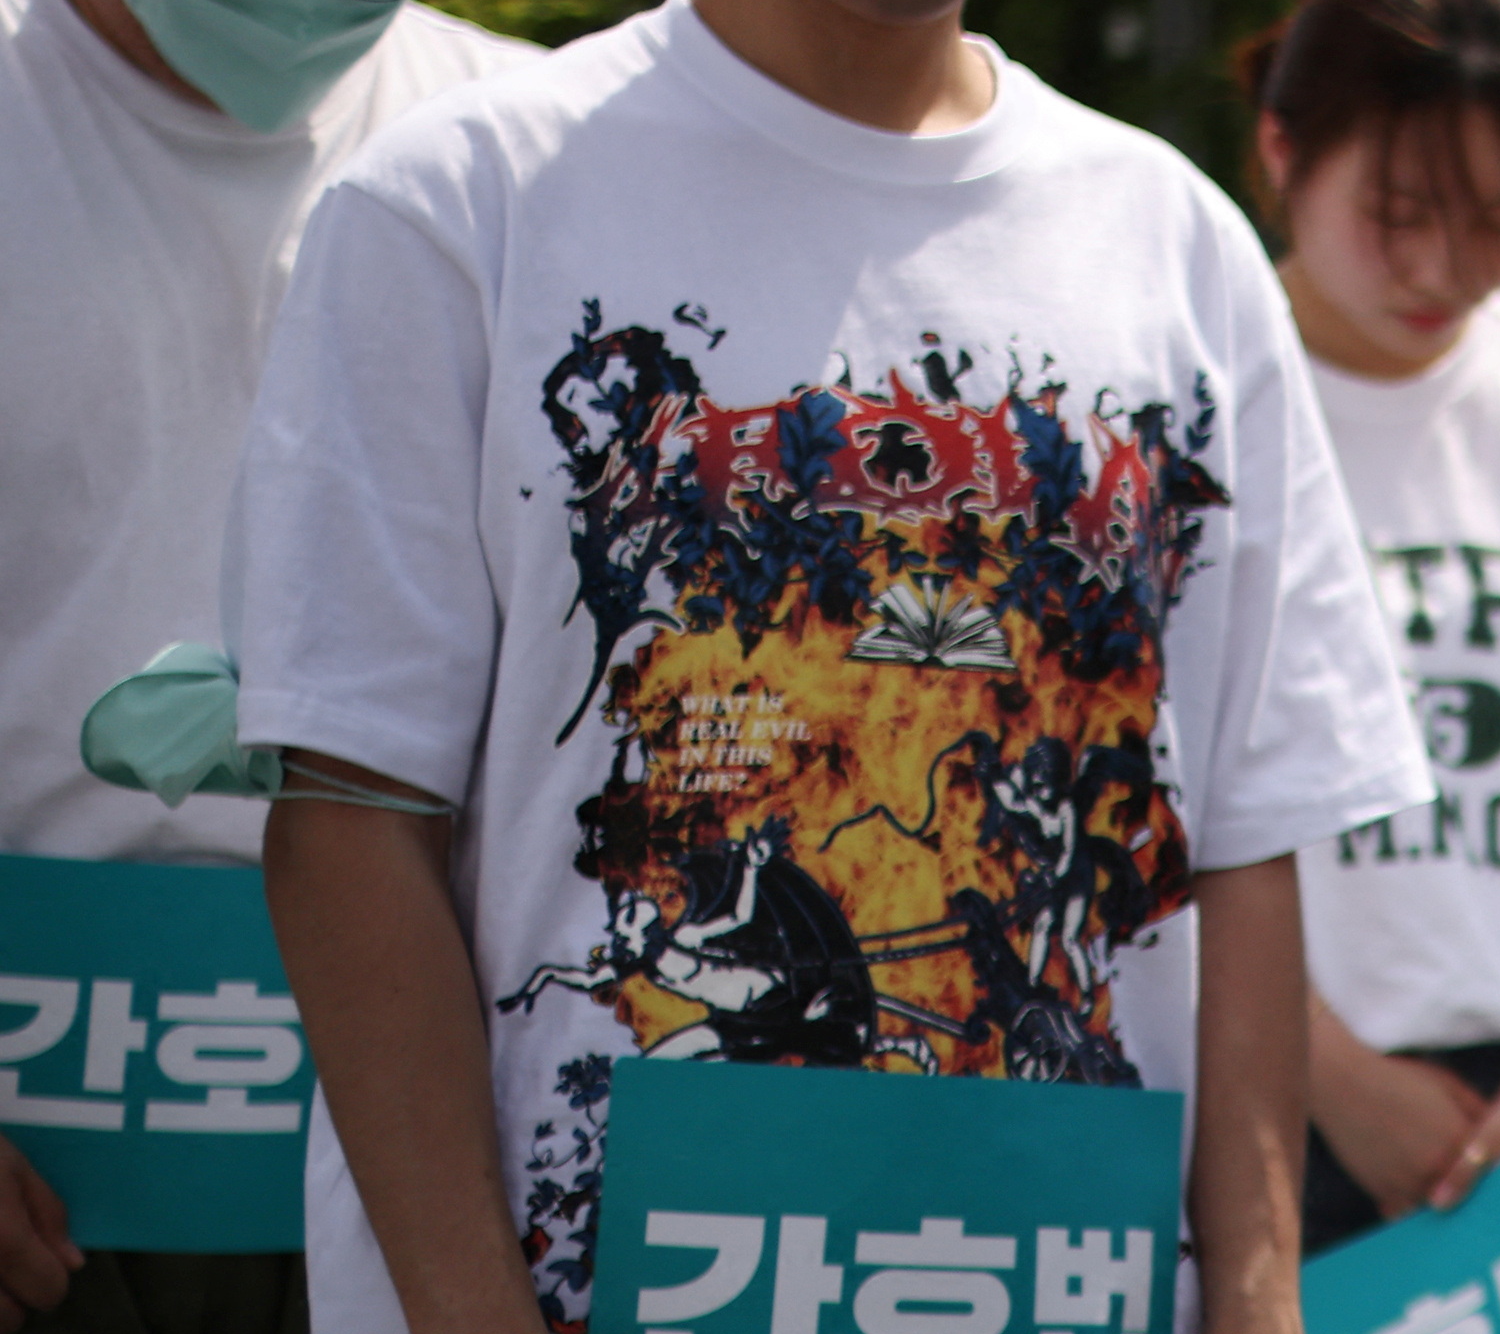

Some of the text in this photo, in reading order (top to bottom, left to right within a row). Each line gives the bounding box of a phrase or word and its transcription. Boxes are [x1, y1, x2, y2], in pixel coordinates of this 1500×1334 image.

[680, 694, 784, 715] WHAT IS
[679, 719, 812, 741] REAL EVIL
[677, 745, 774, 767] IN THIS
[678, 772, 748, 793] LIFE?
